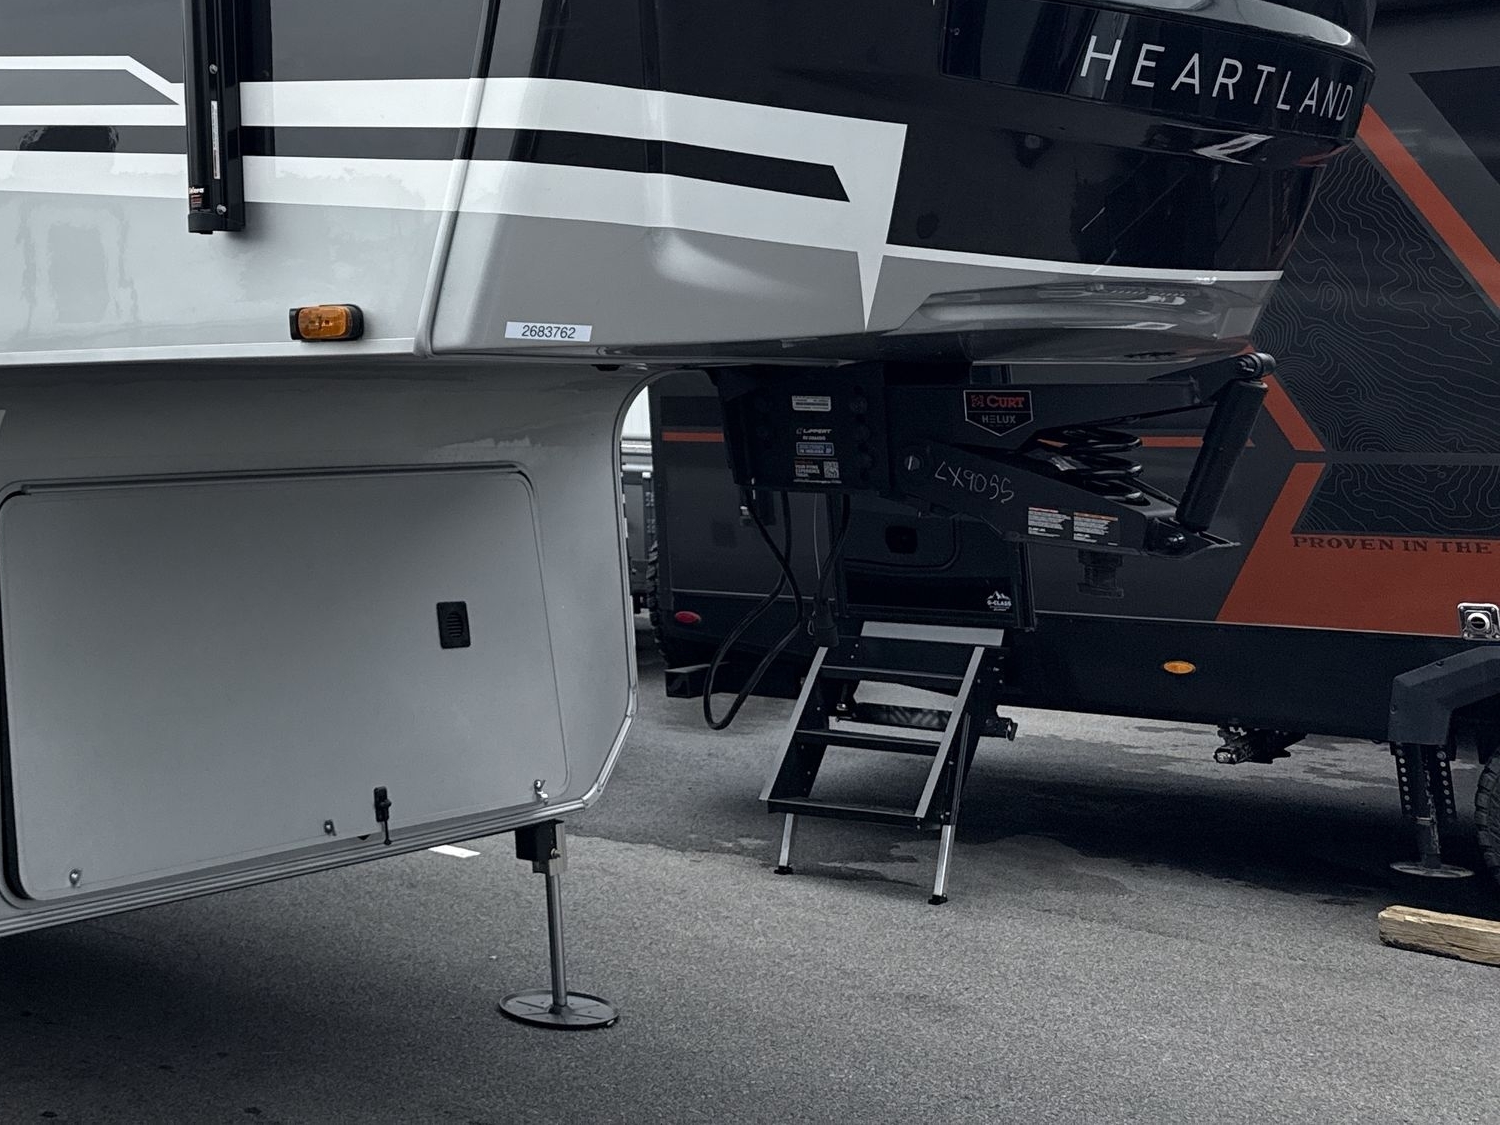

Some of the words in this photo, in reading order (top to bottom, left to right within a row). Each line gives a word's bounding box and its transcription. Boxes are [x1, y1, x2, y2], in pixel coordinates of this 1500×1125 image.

[1080, 35, 1353, 122] HEARTLAND
[521, 325, 576, 339] 2683762
[1292, 536, 1394, 551] PROVEN
[1402, 539, 1428, 552] IN
[1436, 541, 1492, 554] THE
